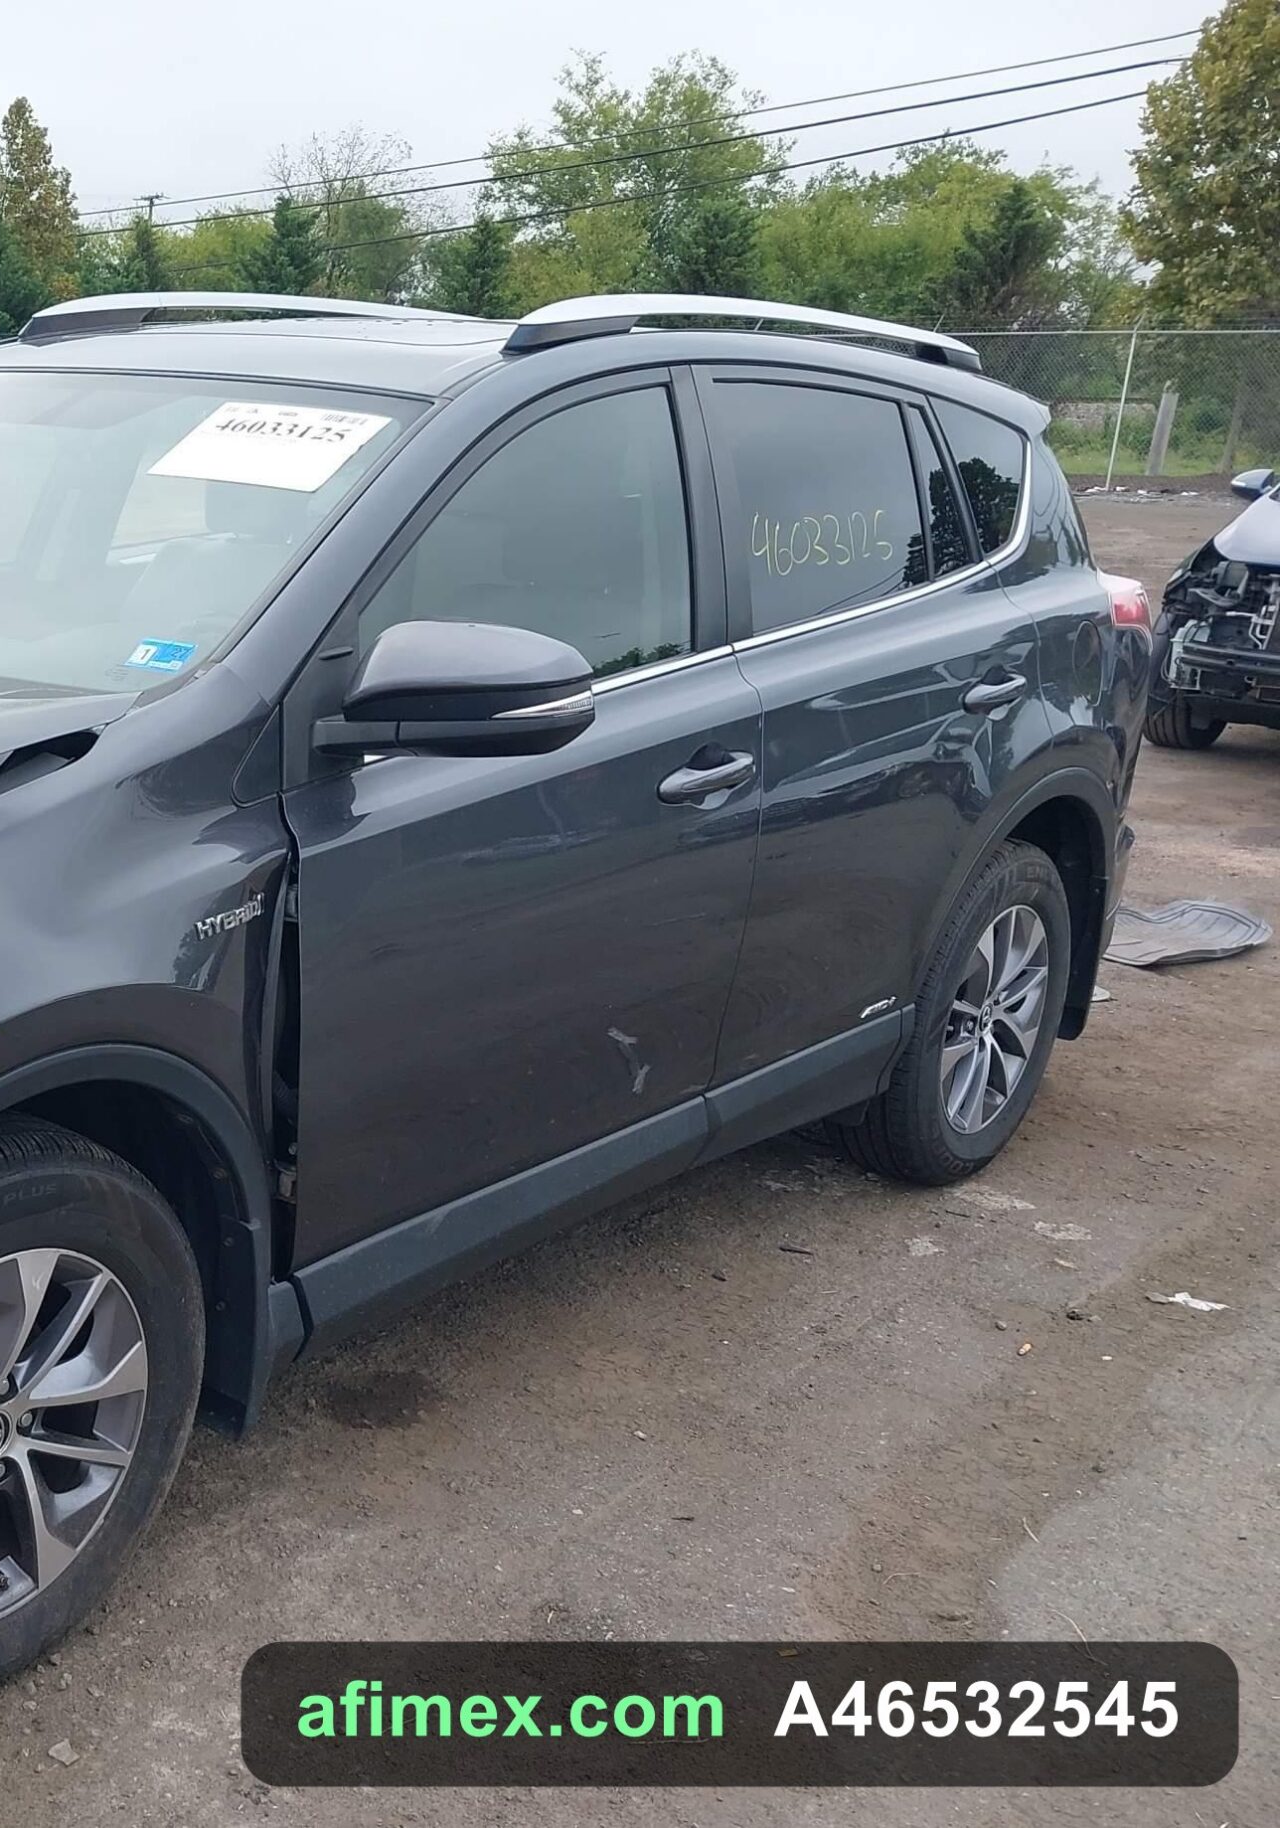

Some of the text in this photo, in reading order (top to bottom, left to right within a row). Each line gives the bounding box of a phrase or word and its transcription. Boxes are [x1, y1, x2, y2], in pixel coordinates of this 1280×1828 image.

[216, 418, 352, 443] 46033125
[751, 510, 894, 576] 46033125
[195, 892, 265, 940] HYBRID
